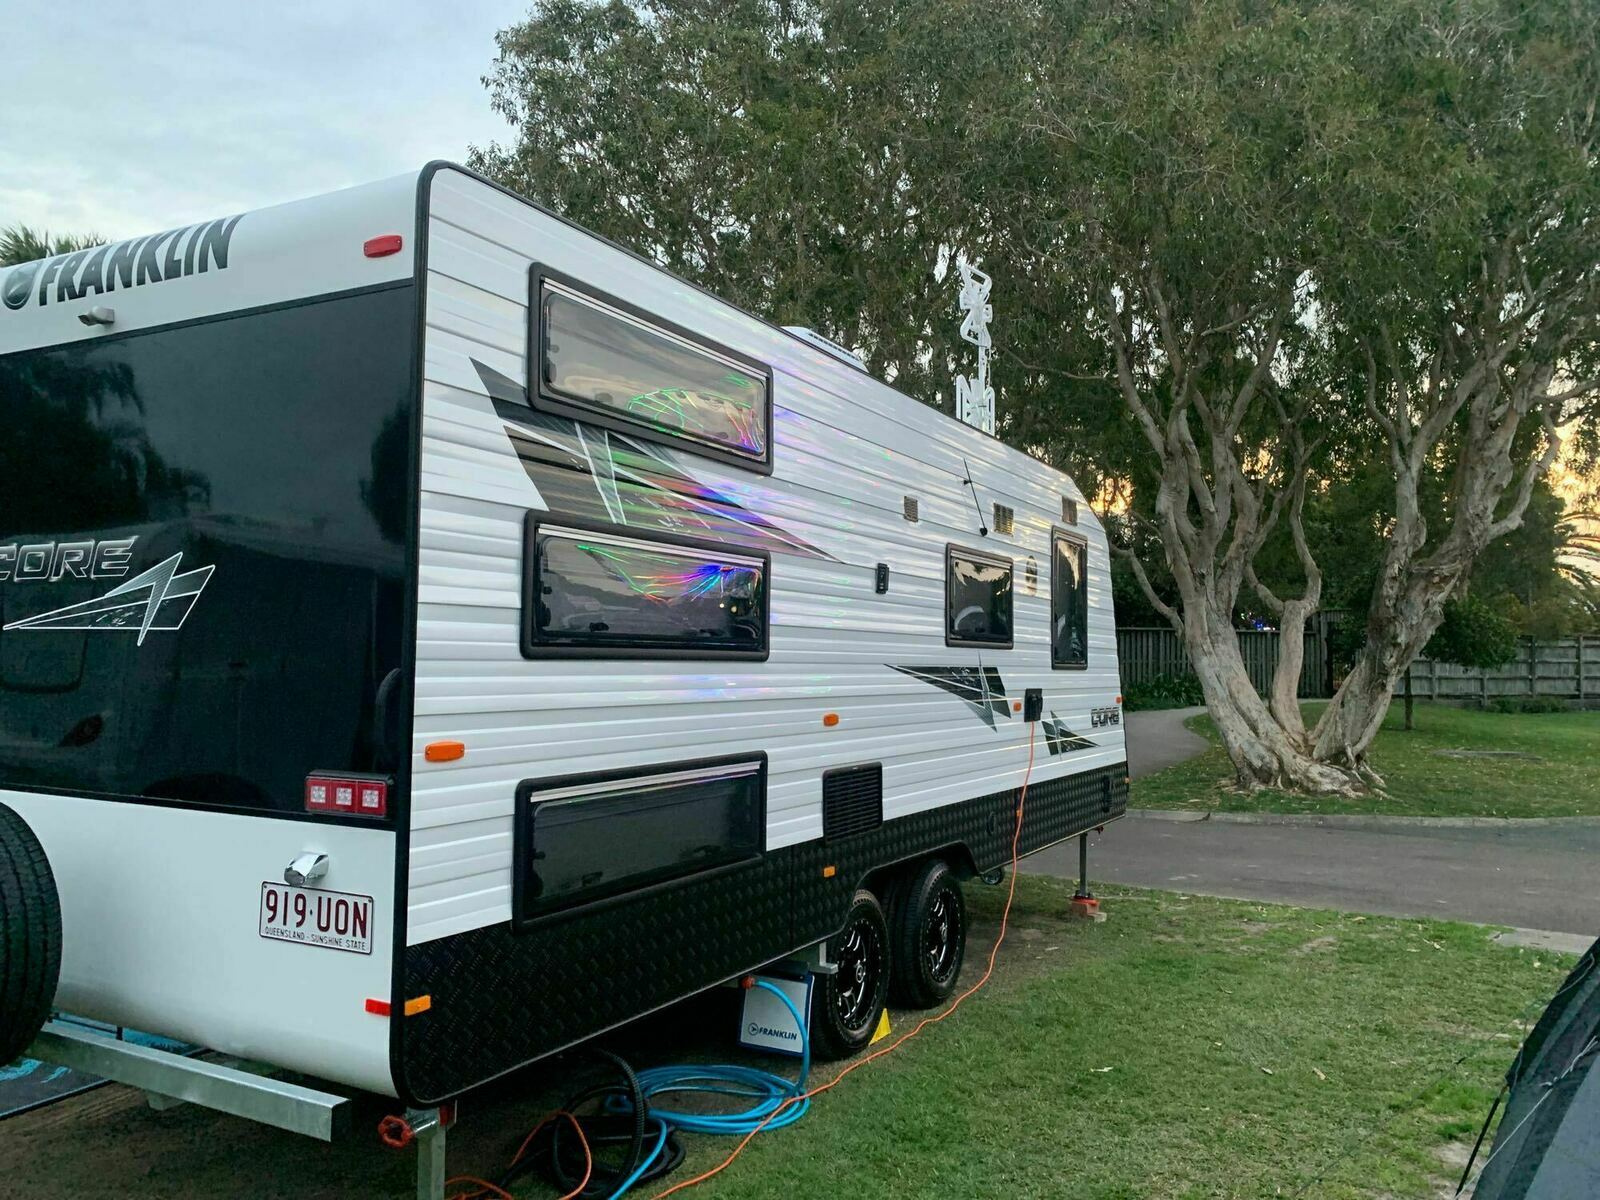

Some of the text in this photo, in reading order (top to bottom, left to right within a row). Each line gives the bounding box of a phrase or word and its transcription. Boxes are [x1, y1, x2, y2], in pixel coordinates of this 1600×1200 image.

[39, 213, 246, 306] FRANKLIN
[1090, 706, 1120, 728] CORE
[264, 926, 305, 940] QUEENSLAND
[311, 933, 343, 947] SUNSHINE
[345, 941, 367, 951] STATE
[758, 1026, 798, 1041] FRANKLIN
